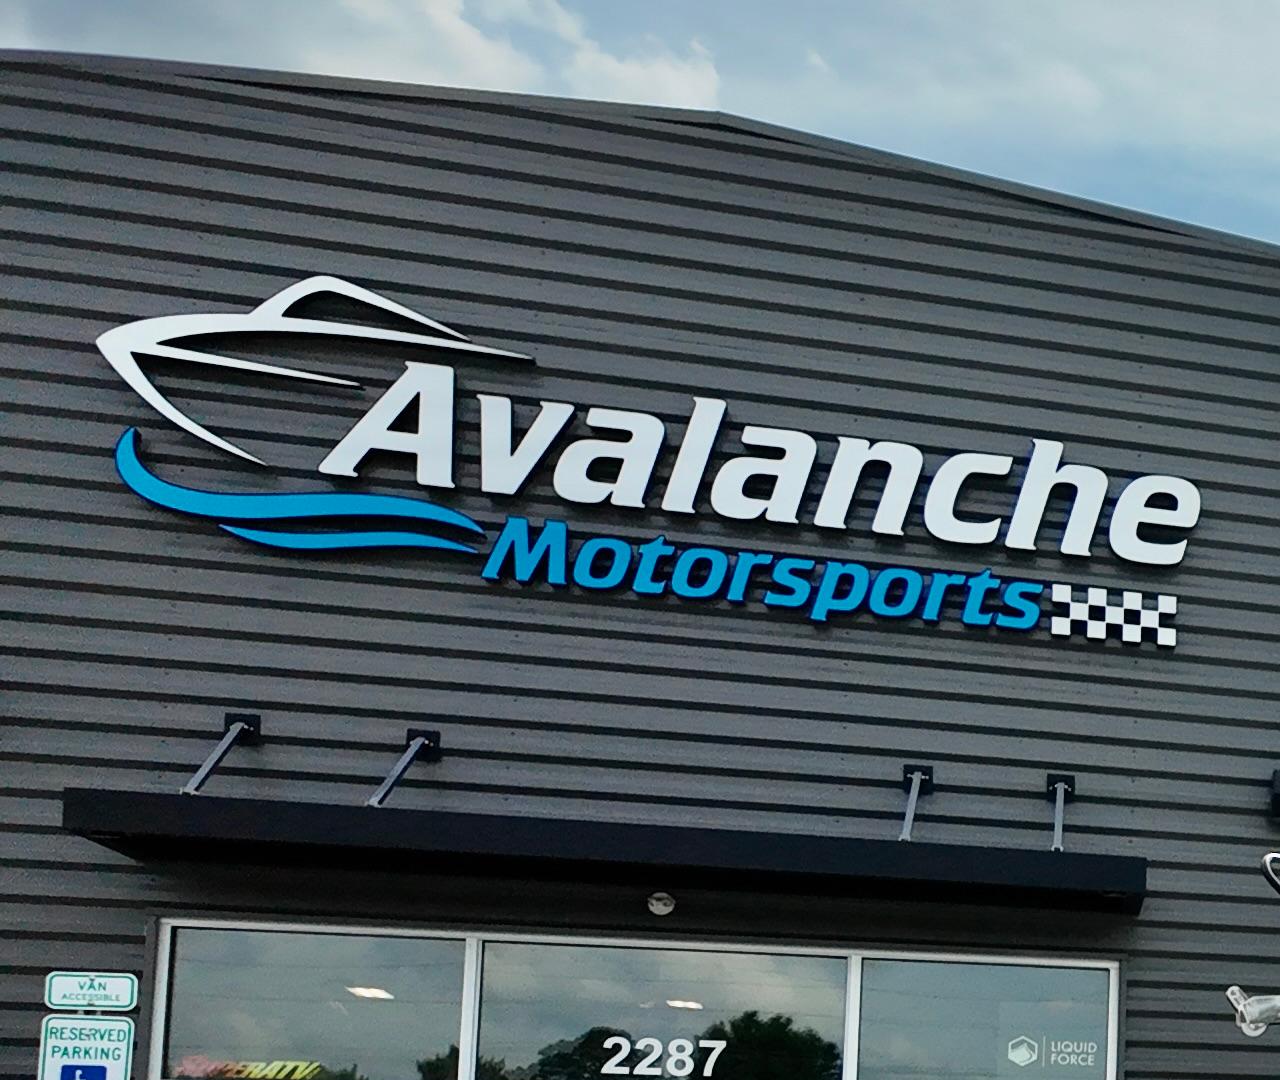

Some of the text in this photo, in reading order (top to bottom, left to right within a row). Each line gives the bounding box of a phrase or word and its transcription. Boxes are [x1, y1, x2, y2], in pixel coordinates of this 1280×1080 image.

[318, 360, 1201, 566] Avalanche
[481, 515, 1044, 631] Motorsports
[77, 981, 107, 991] VAN
[61, 993, 121, 1002] ACCESSIBLE
[49, 1027, 127, 1042] RESERVED
[51, 1045, 122, 1061] PARKING
[1051, 1041, 1097, 1053] LIQUID
[600, 1036, 727, 1077] 2287
[1050, 1054, 1095, 1066] FORCE
